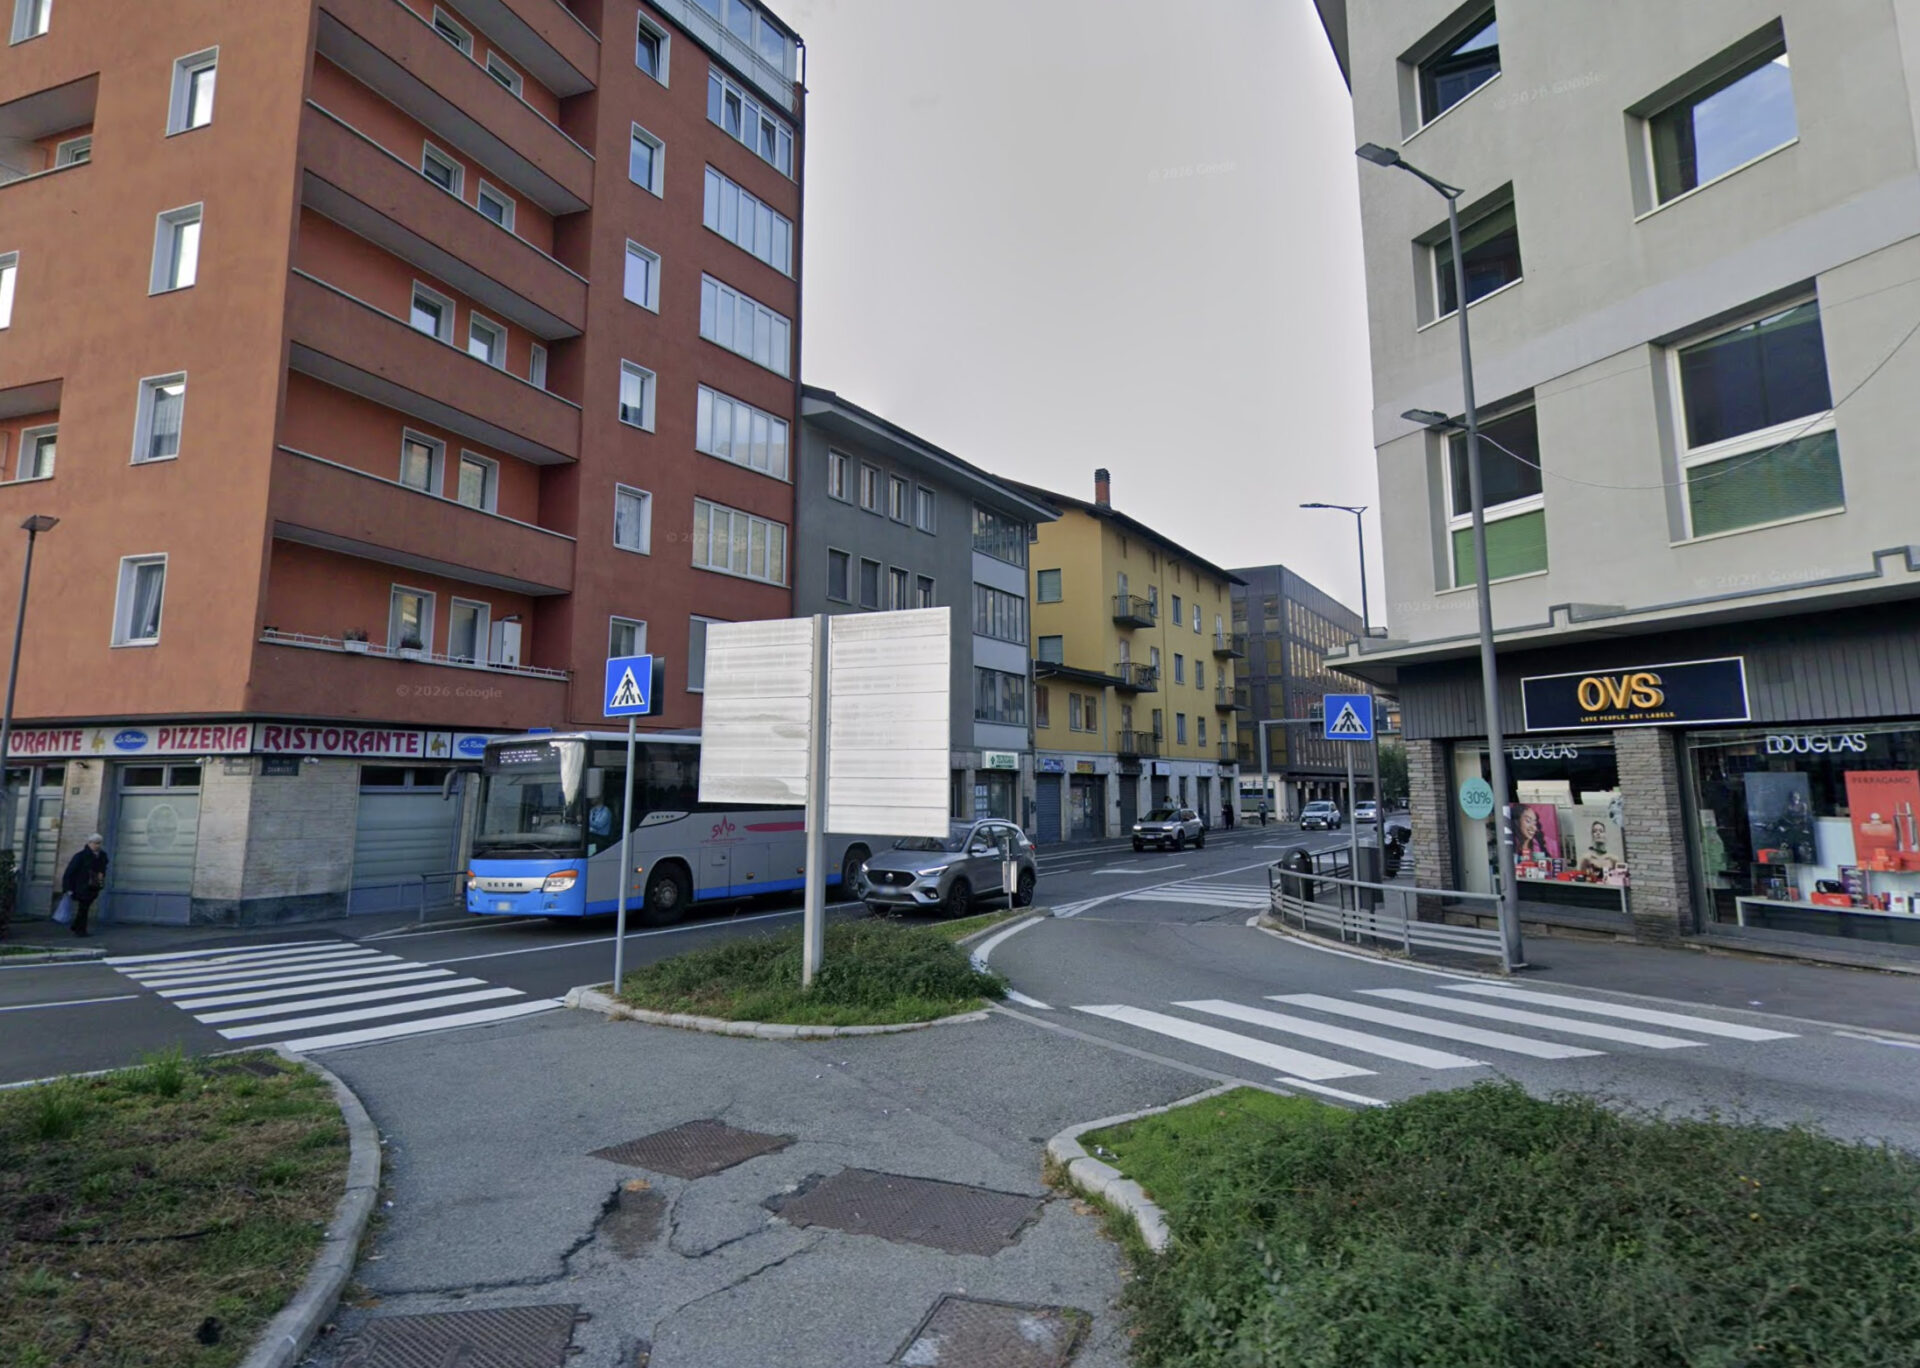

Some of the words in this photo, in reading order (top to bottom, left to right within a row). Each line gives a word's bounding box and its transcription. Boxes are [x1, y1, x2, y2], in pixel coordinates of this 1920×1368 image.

[1577, 672, 1665, 712] OVS
[157, 725, 248, 751] PIZZERIA
[263, 725, 419, 754] RISTORANTE
[1765, 733, 1868, 755] DOUGLAS
[1511, 743, 1579, 760] DOUGLAS
[1463, 790, 1492, 805] -30%
